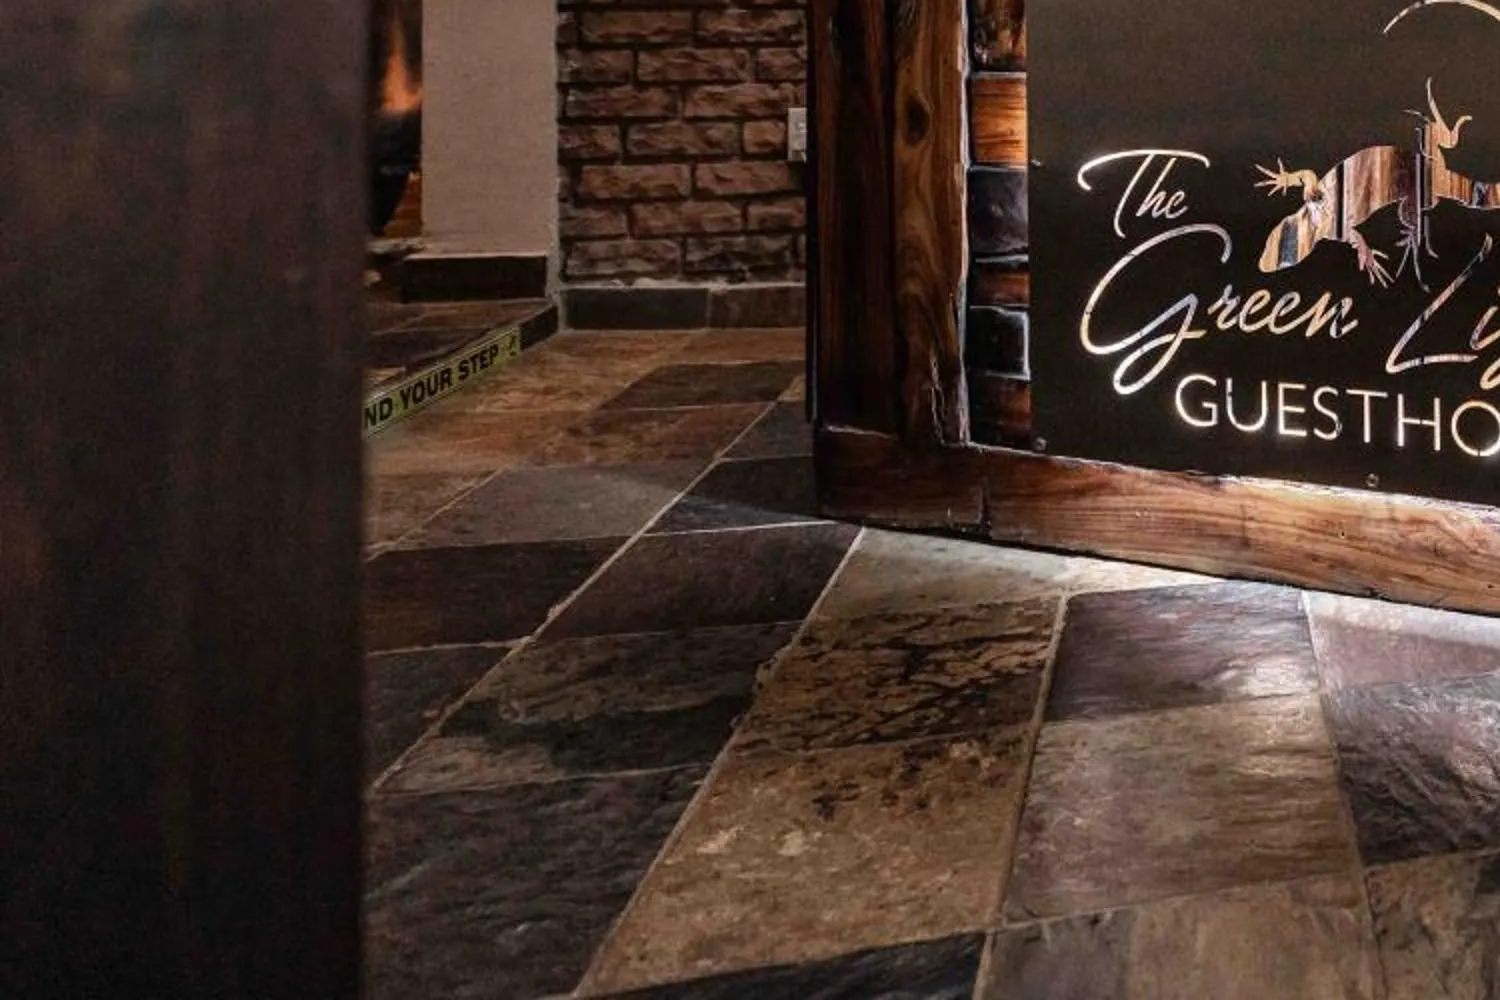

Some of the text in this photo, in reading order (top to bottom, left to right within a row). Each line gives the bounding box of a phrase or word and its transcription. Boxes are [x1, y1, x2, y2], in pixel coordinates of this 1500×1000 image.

[1077, 148, 1210, 237] The
[1081, 223, 1358, 394] Green
[364, 346, 499, 428] ND YOUR STEP
